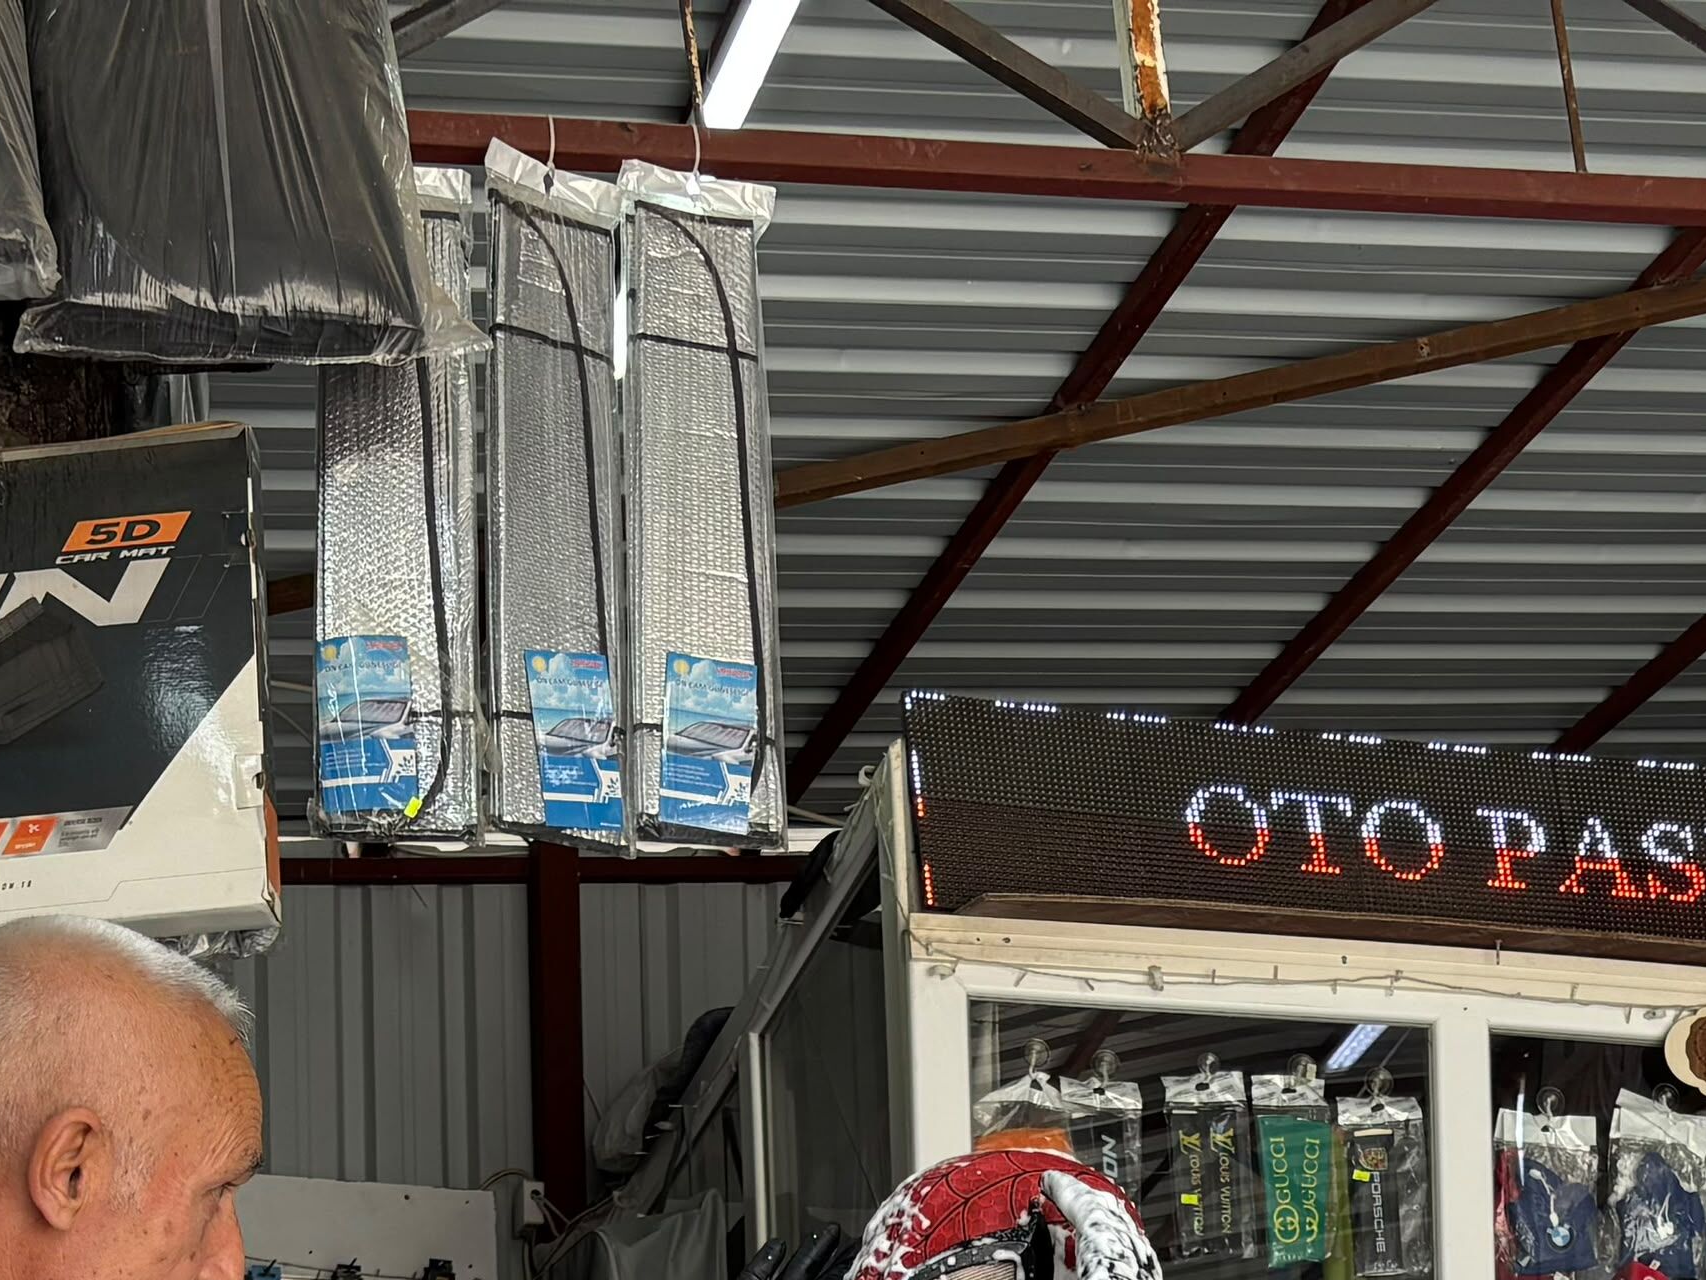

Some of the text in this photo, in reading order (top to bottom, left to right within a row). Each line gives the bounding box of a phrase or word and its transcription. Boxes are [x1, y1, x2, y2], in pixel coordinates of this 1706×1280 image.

[55, 545, 175, 565] CAR MAT
[85, 518, 162, 545] 5D
[1184, 783, 1445, 881] OTO
[1270, 1137, 1291, 1205] GUCCI
[1190, 1188, 1206, 1237] VITTON
[1372, 1170, 1385, 1254] PORSCHE
